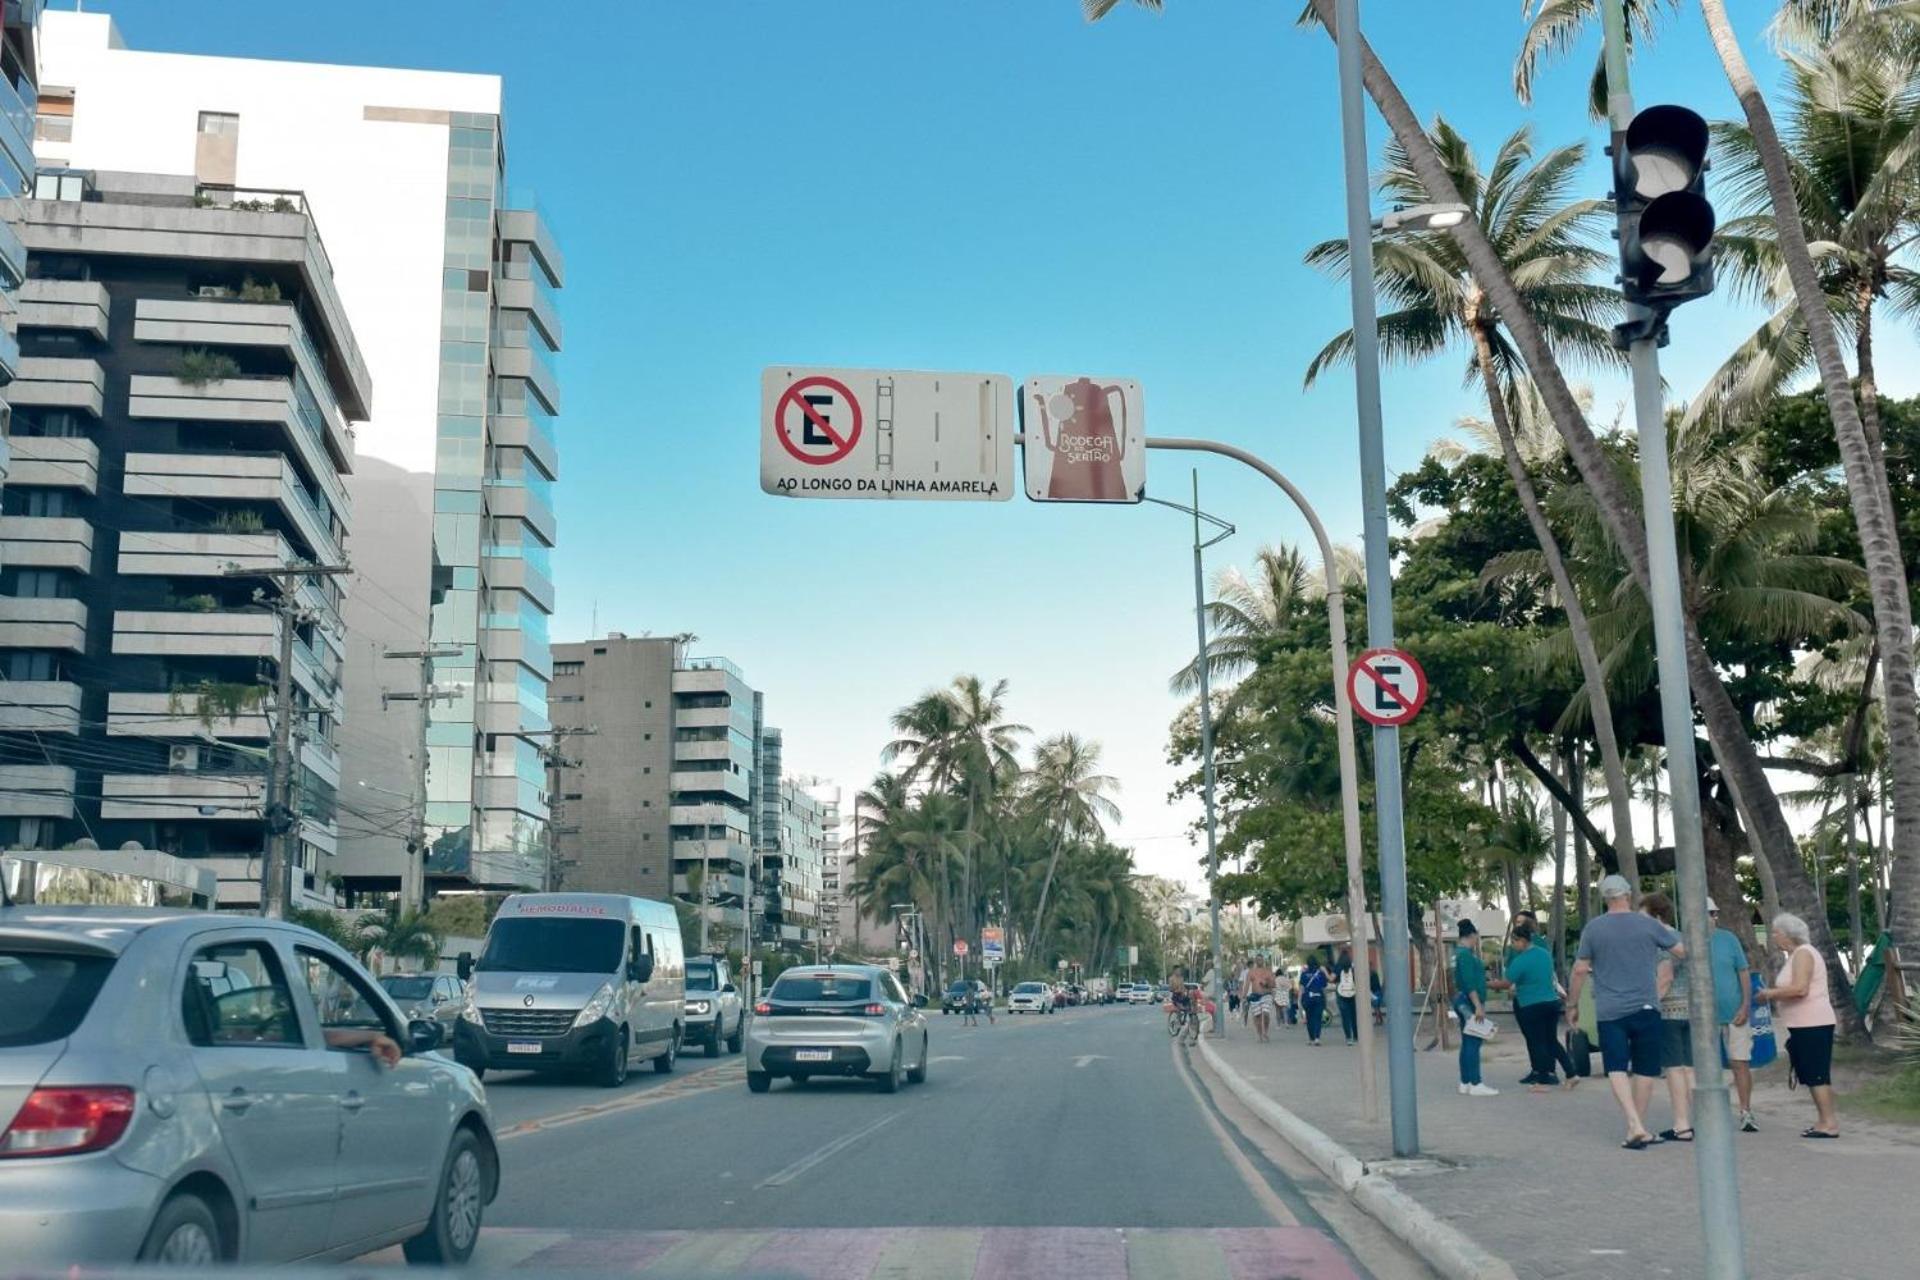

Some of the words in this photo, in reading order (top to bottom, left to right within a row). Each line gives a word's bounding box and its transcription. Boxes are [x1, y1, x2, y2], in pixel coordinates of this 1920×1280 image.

[803, 395, 833, 445] E
[1059, 433, 1113, 453] BODEGA
[777, 478, 798, 490] AO
[802, 478, 852, 490] LONGO
[857, 479, 877, 491] DA
[881, 479, 926, 492] LINHA
[929, 480, 999, 493] AMARELA
[1375, 666, 1402, 709] E
